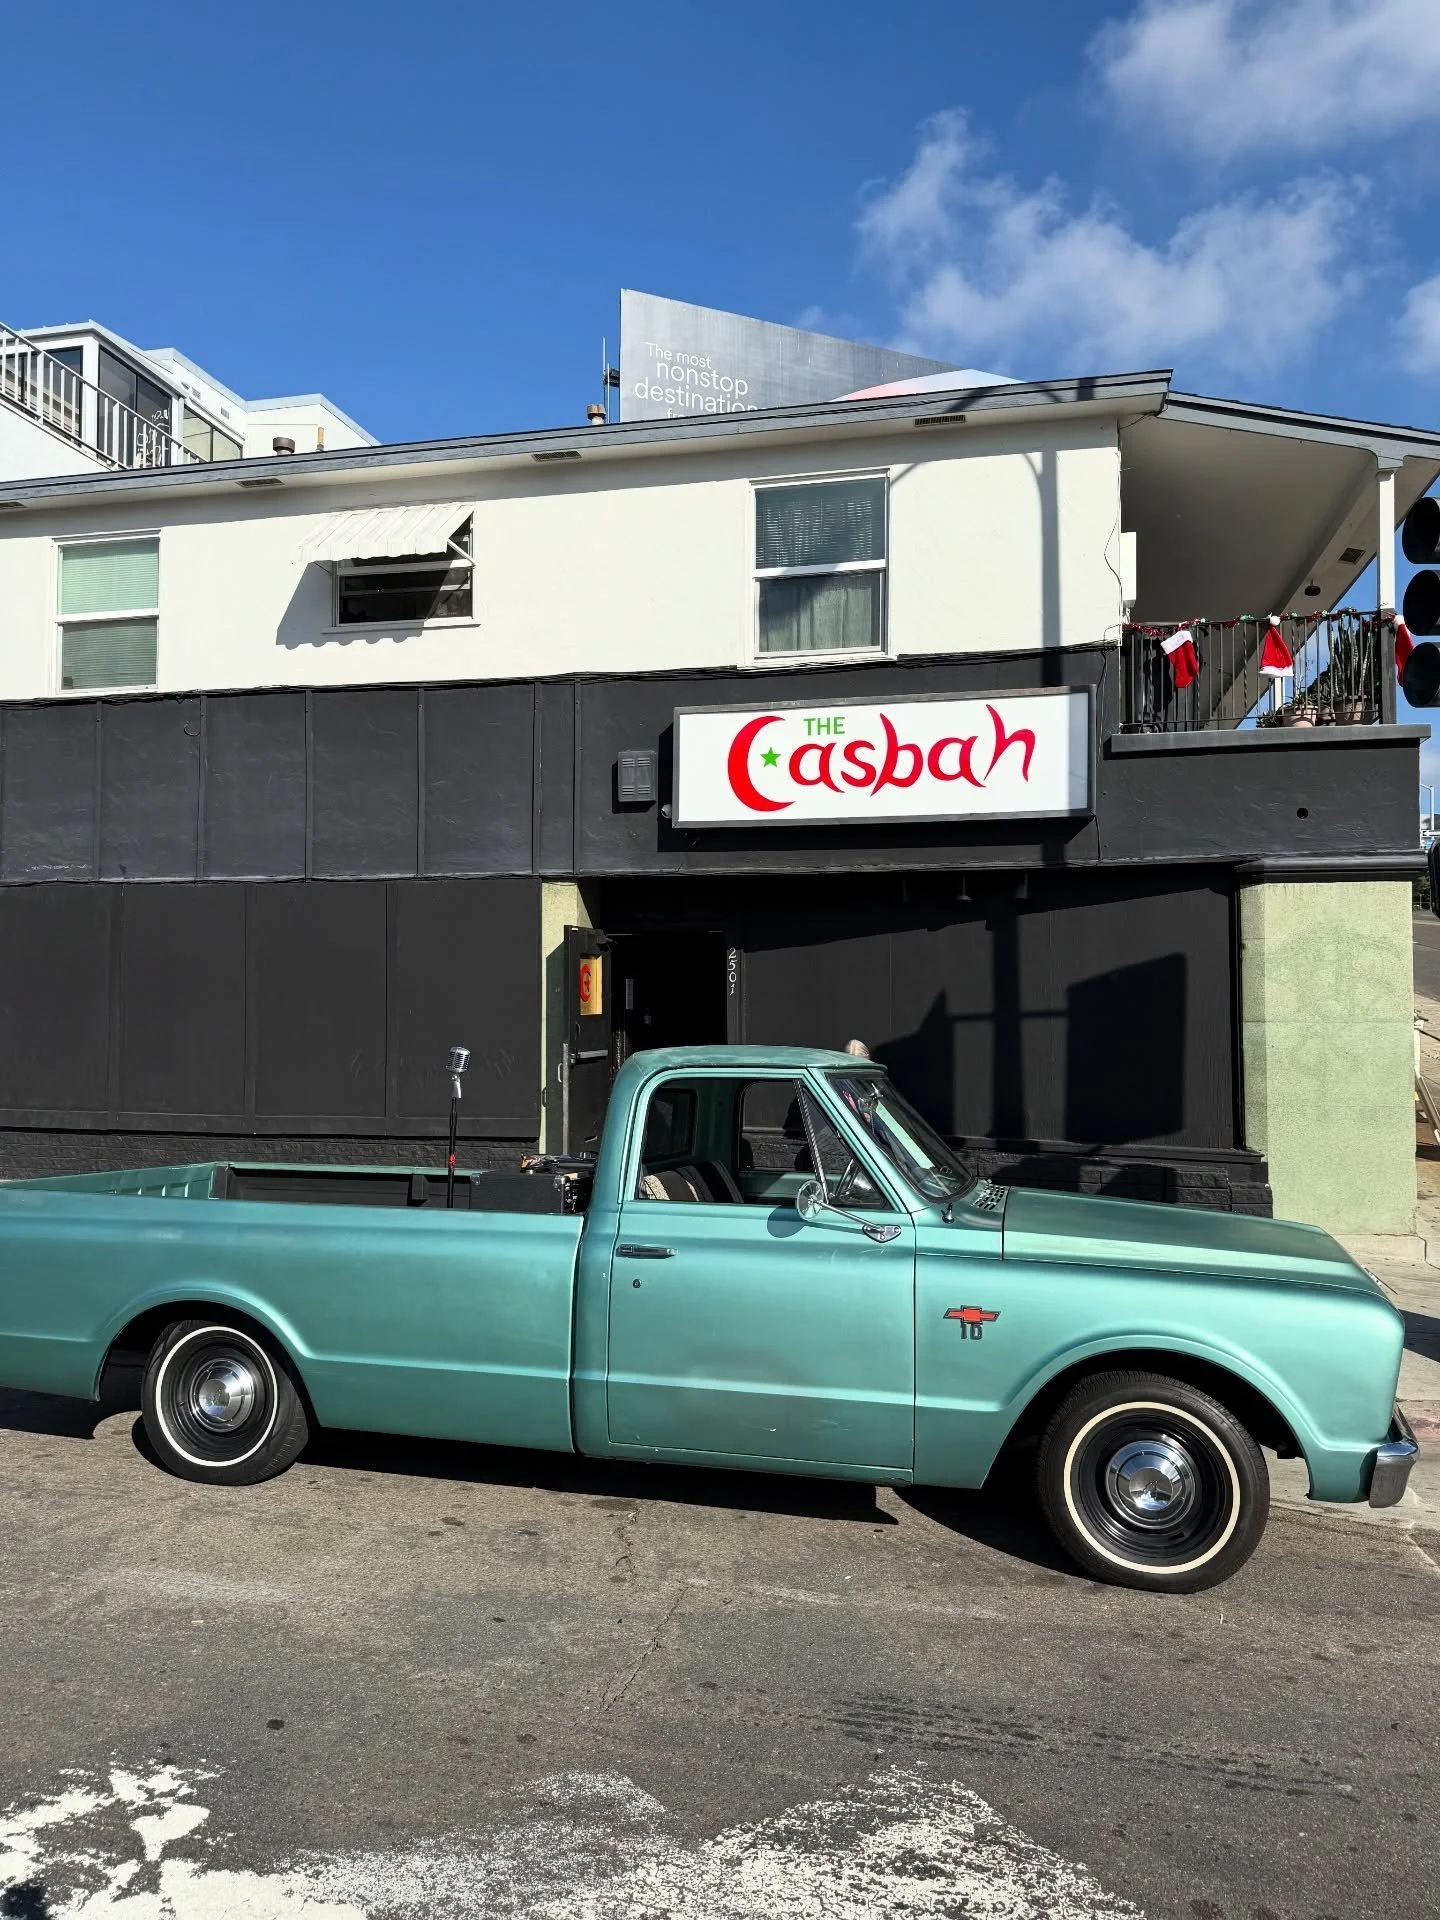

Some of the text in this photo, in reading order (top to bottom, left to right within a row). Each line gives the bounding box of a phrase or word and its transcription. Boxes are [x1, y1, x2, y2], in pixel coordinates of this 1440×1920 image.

[645, 341, 712, 369] The most
[656, 362, 748, 399] nonstop
[803, 716, 846, 737] THE
[727, 703, 1037, 813] Casbah
[727, 946, 738, 996] 2501
[960, 1322, 983, 1340] 10
